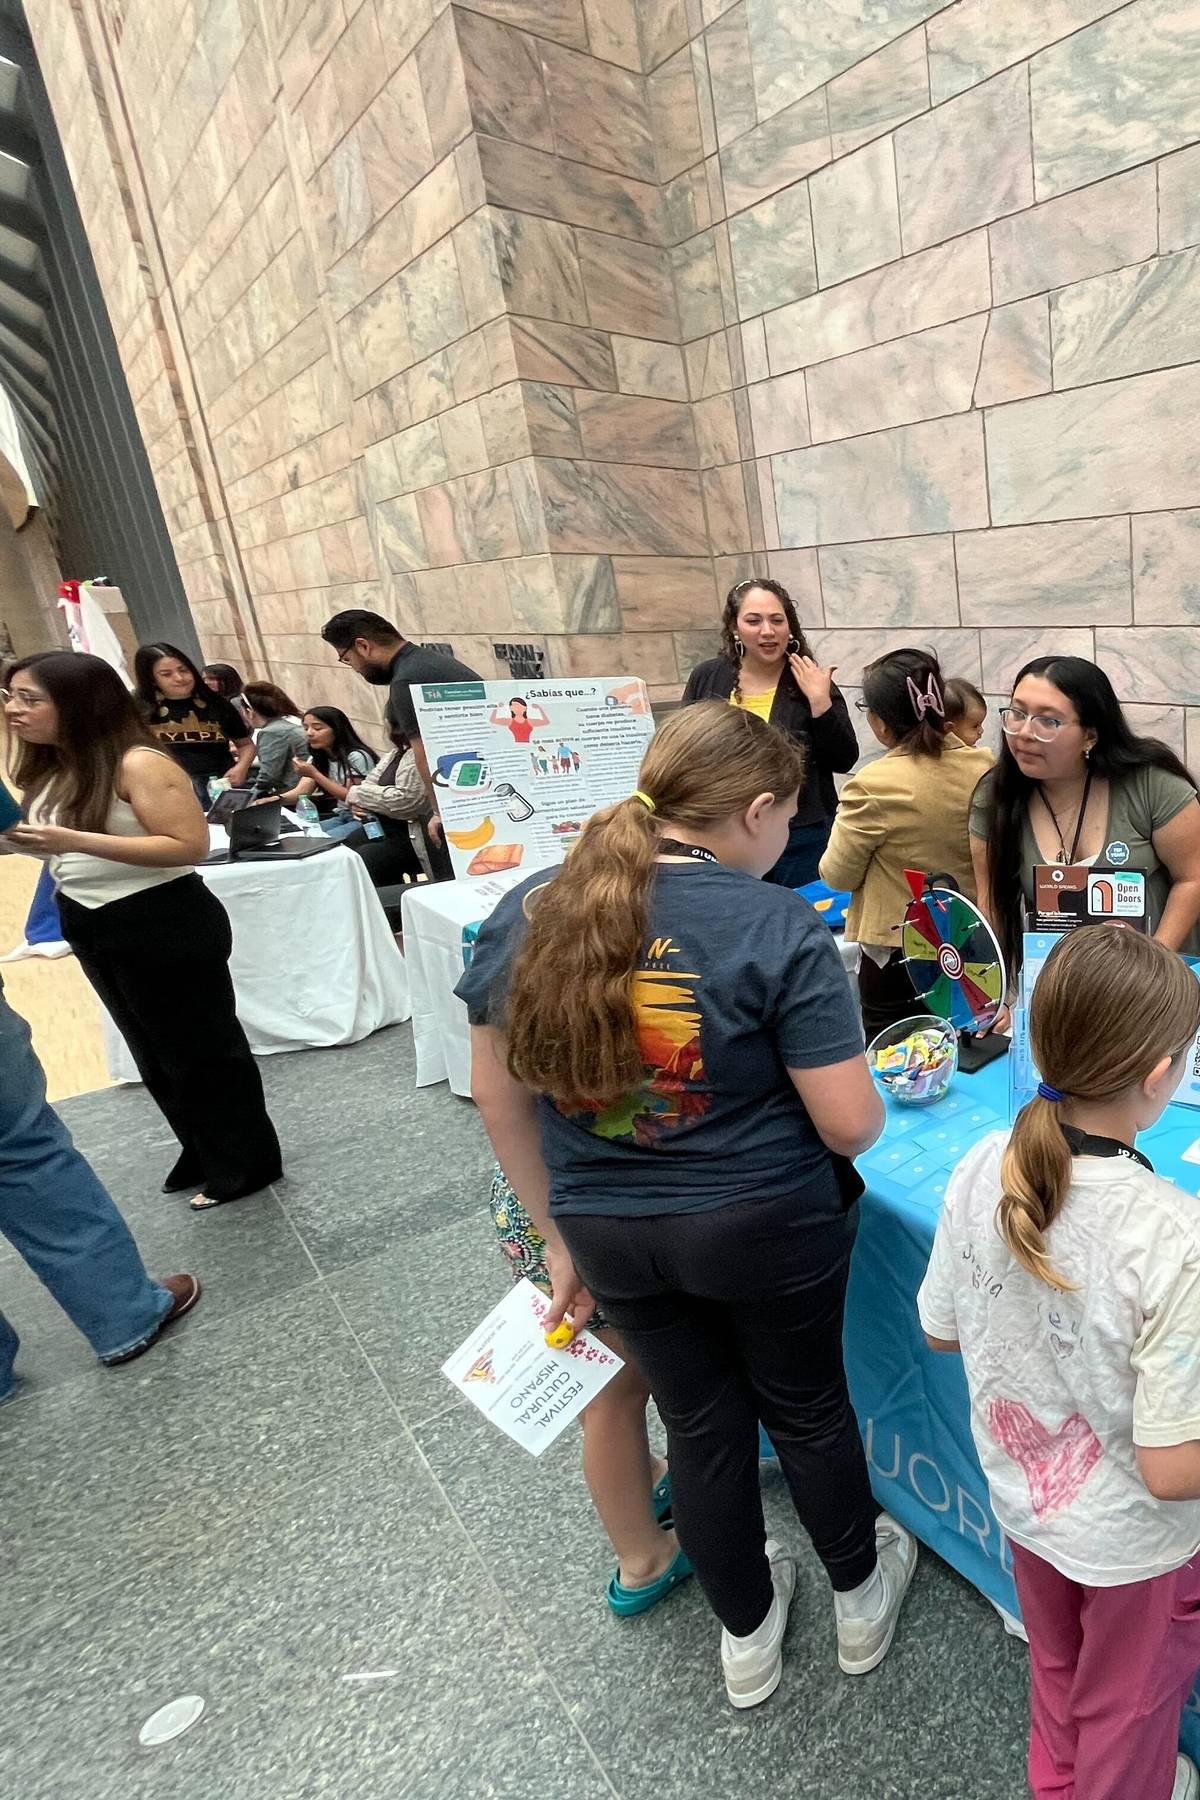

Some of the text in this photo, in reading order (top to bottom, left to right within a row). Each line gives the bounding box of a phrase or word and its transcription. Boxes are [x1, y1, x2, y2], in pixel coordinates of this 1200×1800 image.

[525, 690, 563, 699] ¿Sabías
[163, 731, 226, 741] YLPA
[1117, 883, 1138, 894] Open
[1117, 894, 1142, 902] Doors
[510, 1360, 559, 1409] HISPANO
[514, 1371, 570, 1426] CULTURAL
[534, 1380, 584, 1428] FESTIVAL
